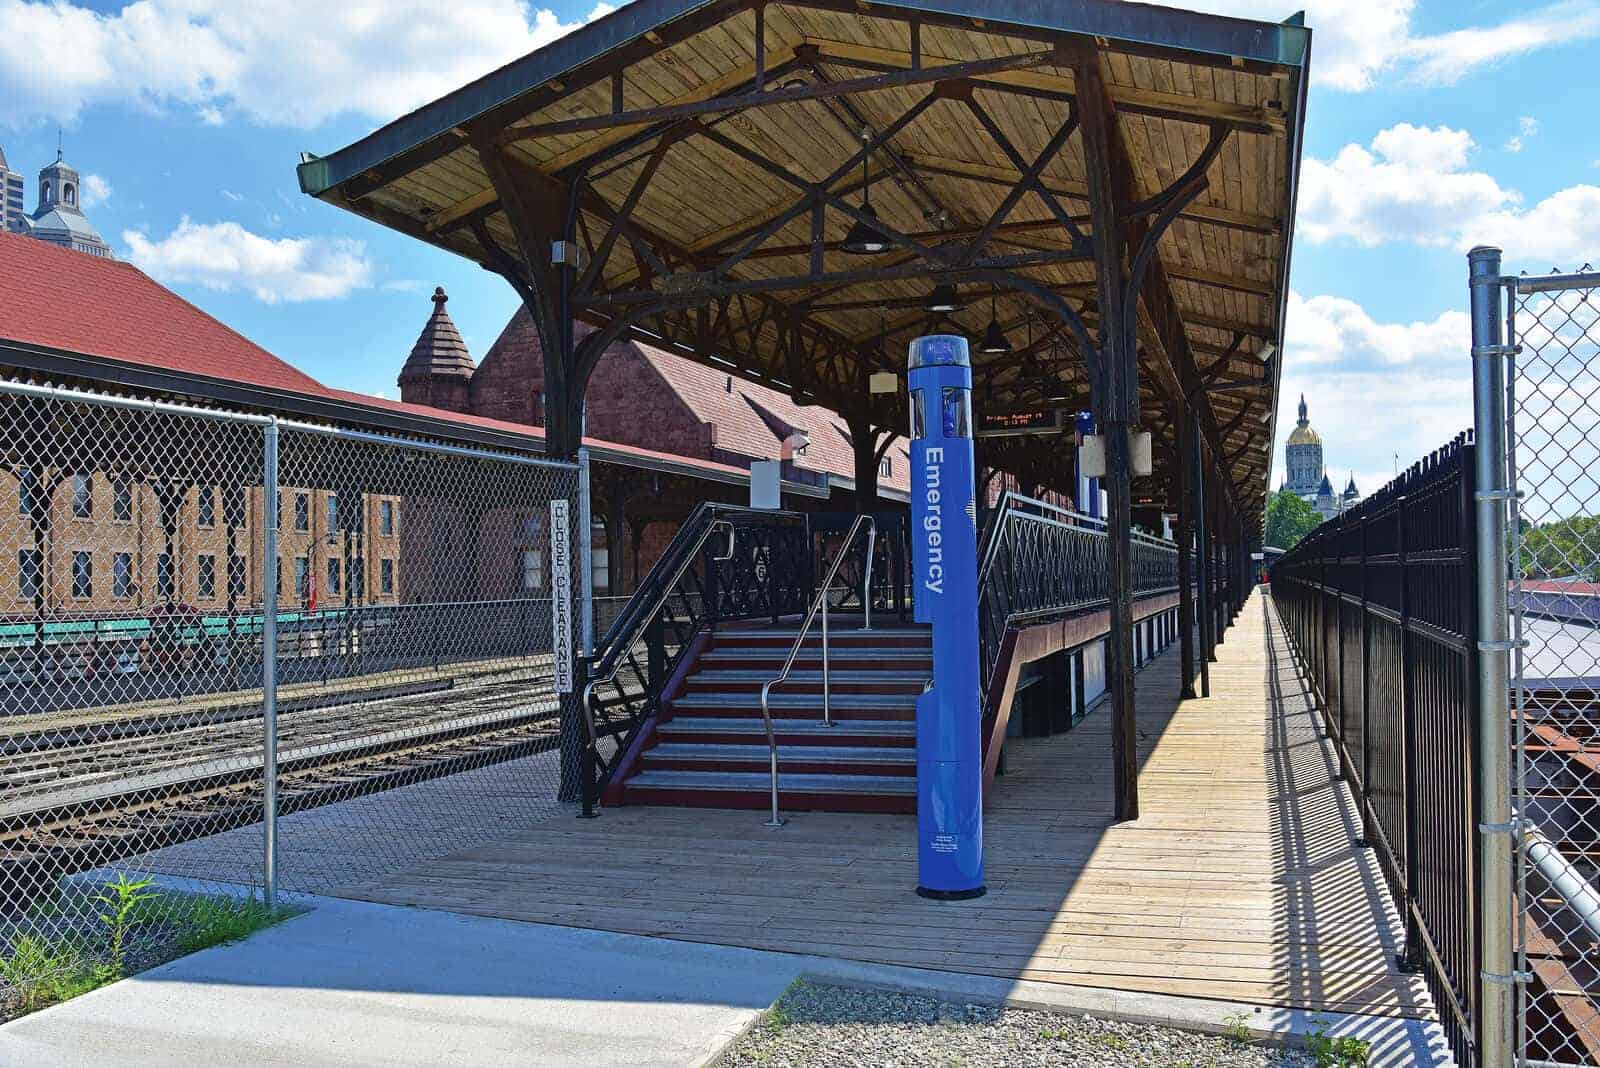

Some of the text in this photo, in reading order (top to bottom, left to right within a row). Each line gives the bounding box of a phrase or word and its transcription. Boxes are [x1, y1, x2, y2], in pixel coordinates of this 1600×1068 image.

[555, 506, 568, 686] CLOSE CLEARANCE
[923, 447, 945, 594] Emergency
